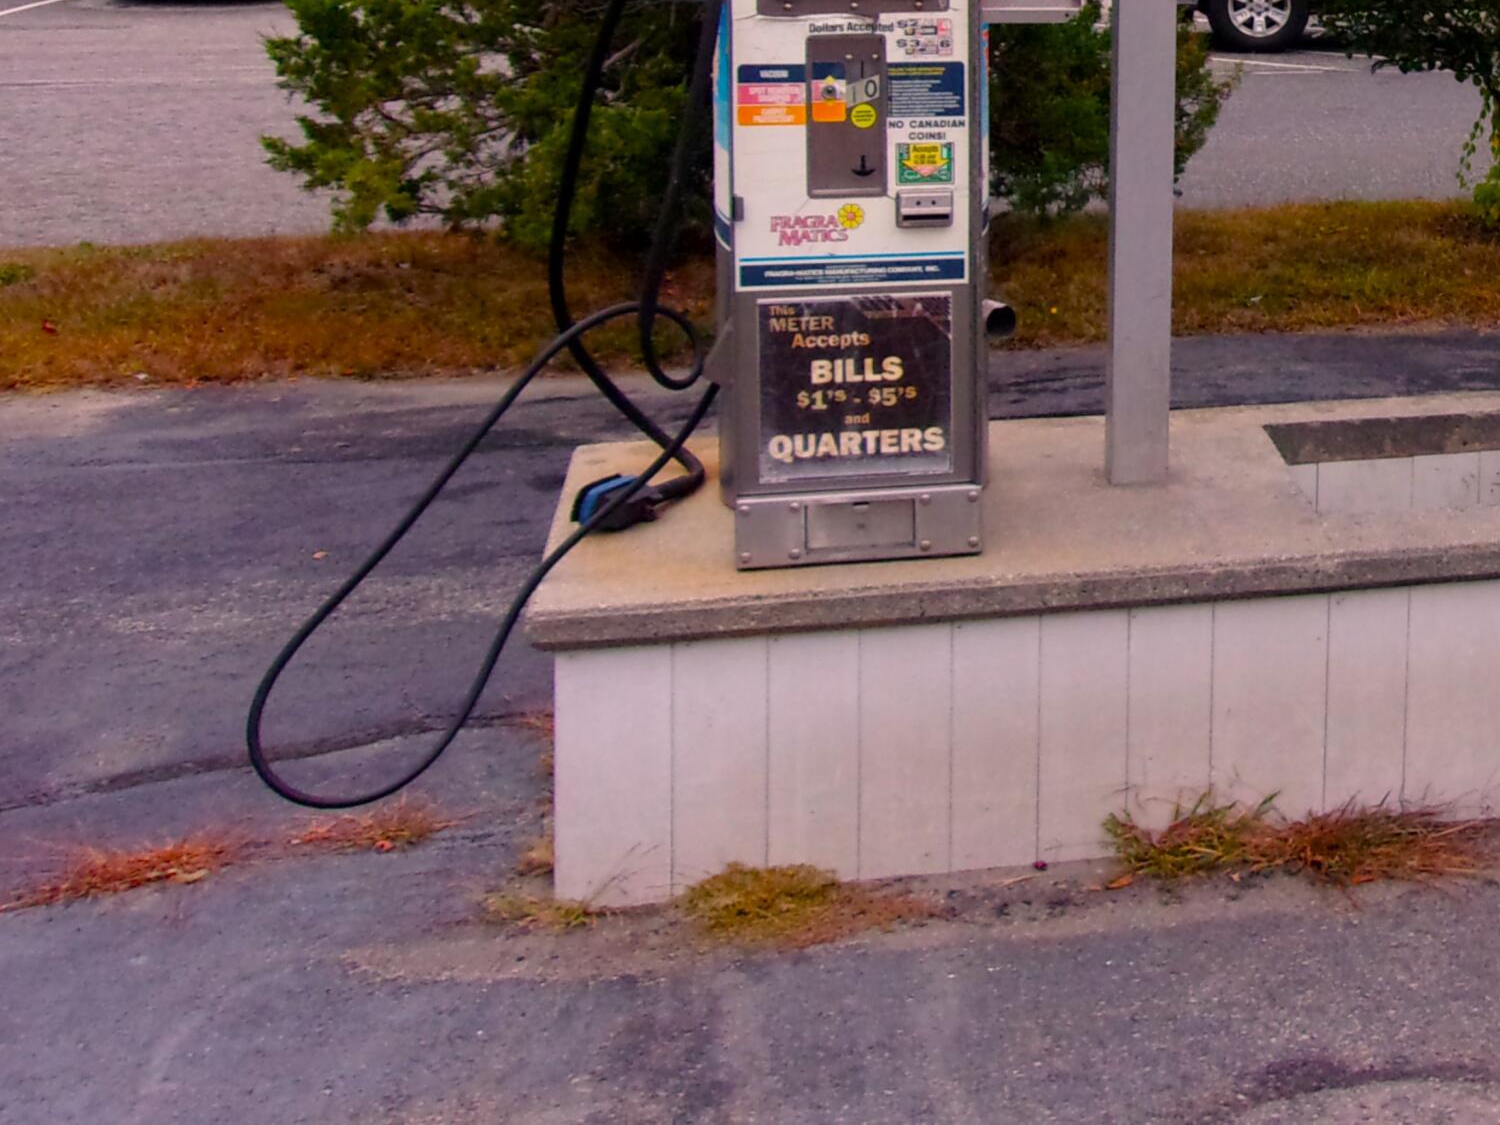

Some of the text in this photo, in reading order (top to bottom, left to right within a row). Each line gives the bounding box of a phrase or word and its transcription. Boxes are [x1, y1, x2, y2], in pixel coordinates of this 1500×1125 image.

[809, 23, 844, 33] Dollars
[888, 120, 965, 129] NO CANADIAN
[908, 132, 946, 140] COINS!
[778, 228, 849, 246] MATICS
[768, 305, 796, 316] This
[768, 316, 835, 333] METER
[791, 331, 872, 349] Accepts
[810, 356, 904, 385] BILLS
[844, 413, 870, 425] and
[768, 427, 945, 463] QUARTERS
